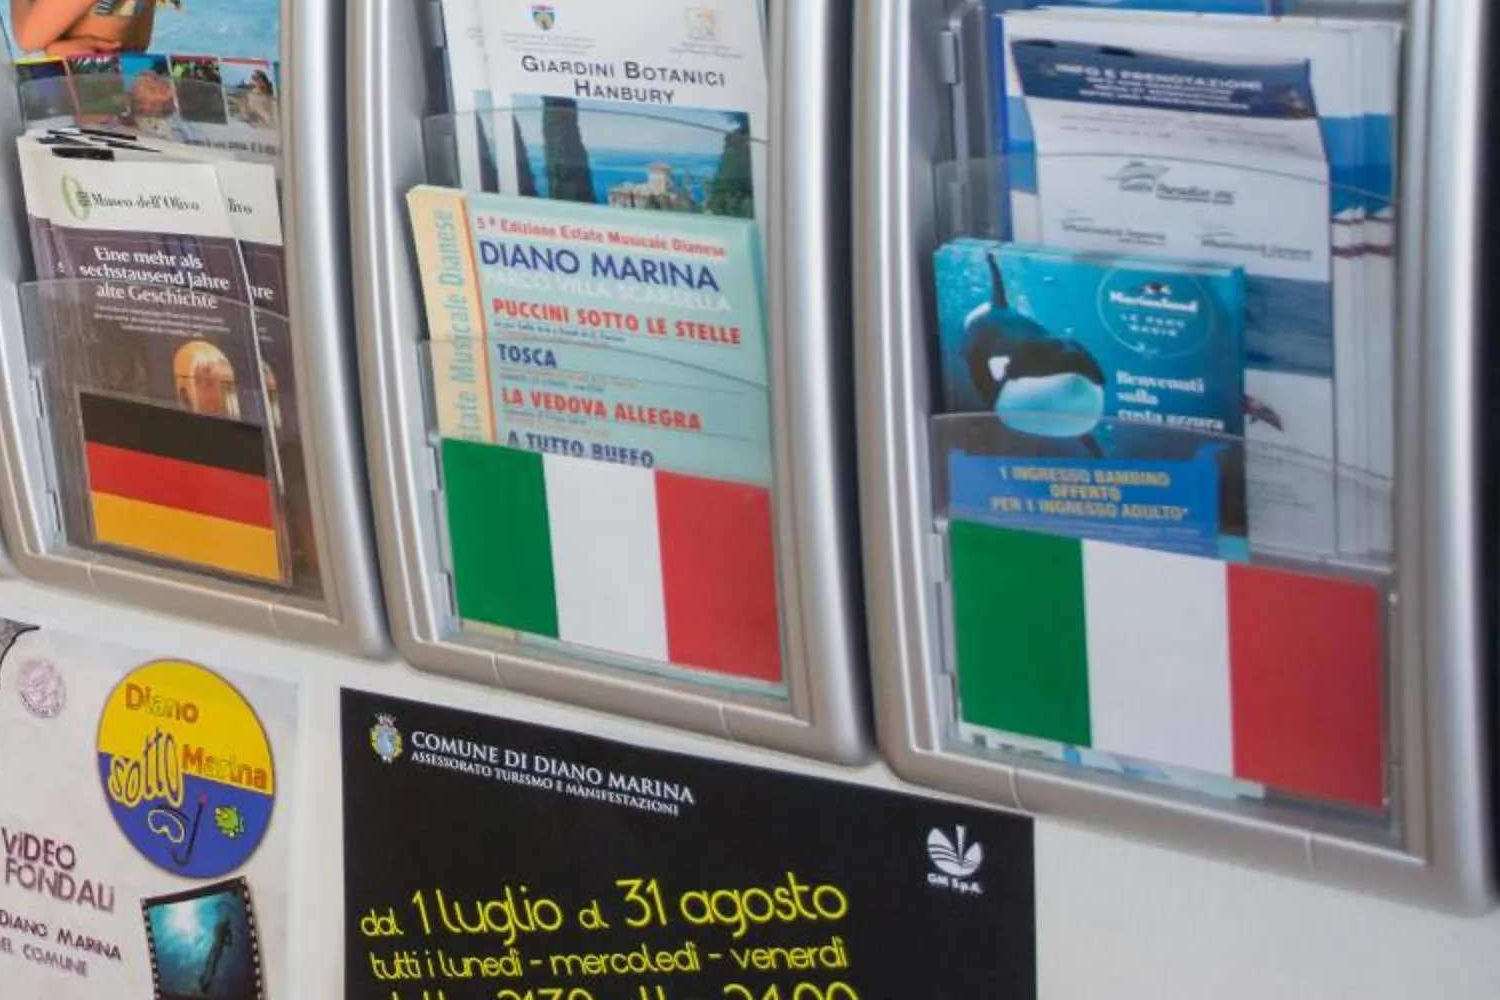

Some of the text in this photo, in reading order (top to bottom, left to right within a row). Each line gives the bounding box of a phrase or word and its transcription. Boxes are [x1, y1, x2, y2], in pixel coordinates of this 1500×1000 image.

[521, 55, 726, 87] GIARDINI BOTANICI
[575, 79, 675, 104] HANBURY
[434, 210, 464, 287] Dianese
[477, 217, 726, 257] 5 Edizione Estate Musicale Dianese
[79, 264, 230, 291] sechstausend Jahre
[94, 247, 203, 268] Eine mehr als
[480, 240, 720, 293] DIANO MARINA
[96, 281, 219, 309] alte Geschichte
[491, 298, 570, 324] PUCCINI
[577, 308, 639, 332] SOTTO
[646, 317, 668, 336] LE
[675, 320, 742, 346] STELLE
[497, 343, 558, 369] TOSCA
[1116, 369, 1205, 394] Benvenuti
[1116, 388, 1160, 406] sulla
[502, 387, 524, 406] LA
[530, 390, 607, 419] VEDOVA
[614, 402, 702, 431] ALLEGRA
[1117, 409, 1163, 424] costa
[507, 429, 655, 469] A TUTTO BUFFO
[126, 682, 199, 724] Diano
[110, 727, 181, 804] sotto
[182, 744, 268, 790] Marina
[411, 730, 697, 805] COMUNE DI DIANO MARINA
[411, 750, 680, 817] ASSESSORATO TURISMO E MANIFESTAZIONI
[361, 870, 849, 947] dal 1 luglio al 31 agosto
[22, 943, 89, 979] COMUNE
[56, 927, 123, 962] MARINA
[368, 935, 850, 980] tutti i lunedì mercoledì venerdì
